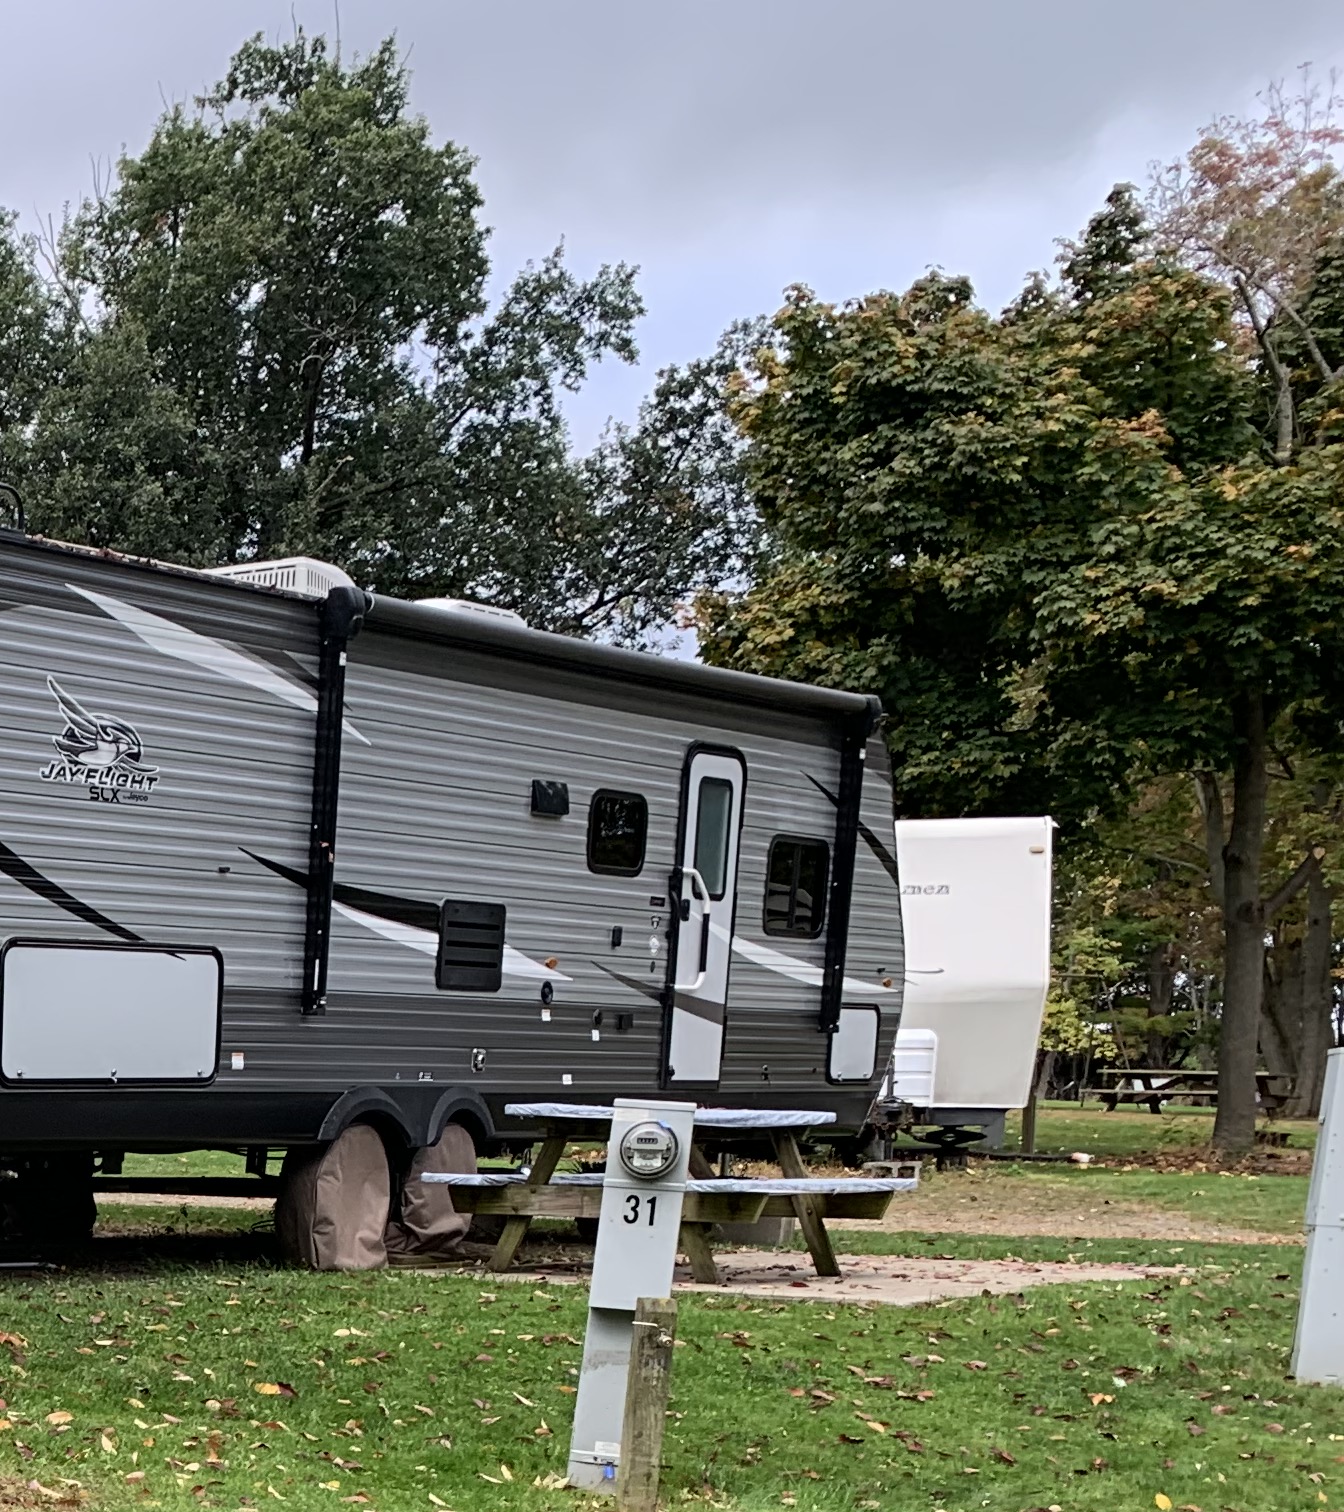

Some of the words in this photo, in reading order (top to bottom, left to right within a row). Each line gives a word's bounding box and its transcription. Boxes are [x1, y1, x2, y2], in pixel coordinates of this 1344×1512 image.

[40, 760, 82, 782] JAY
[82, 766, 160, 792] FLIGHT
[89, 786, 120, 802] SLX
[623, 1194, 658, 1227] 31
